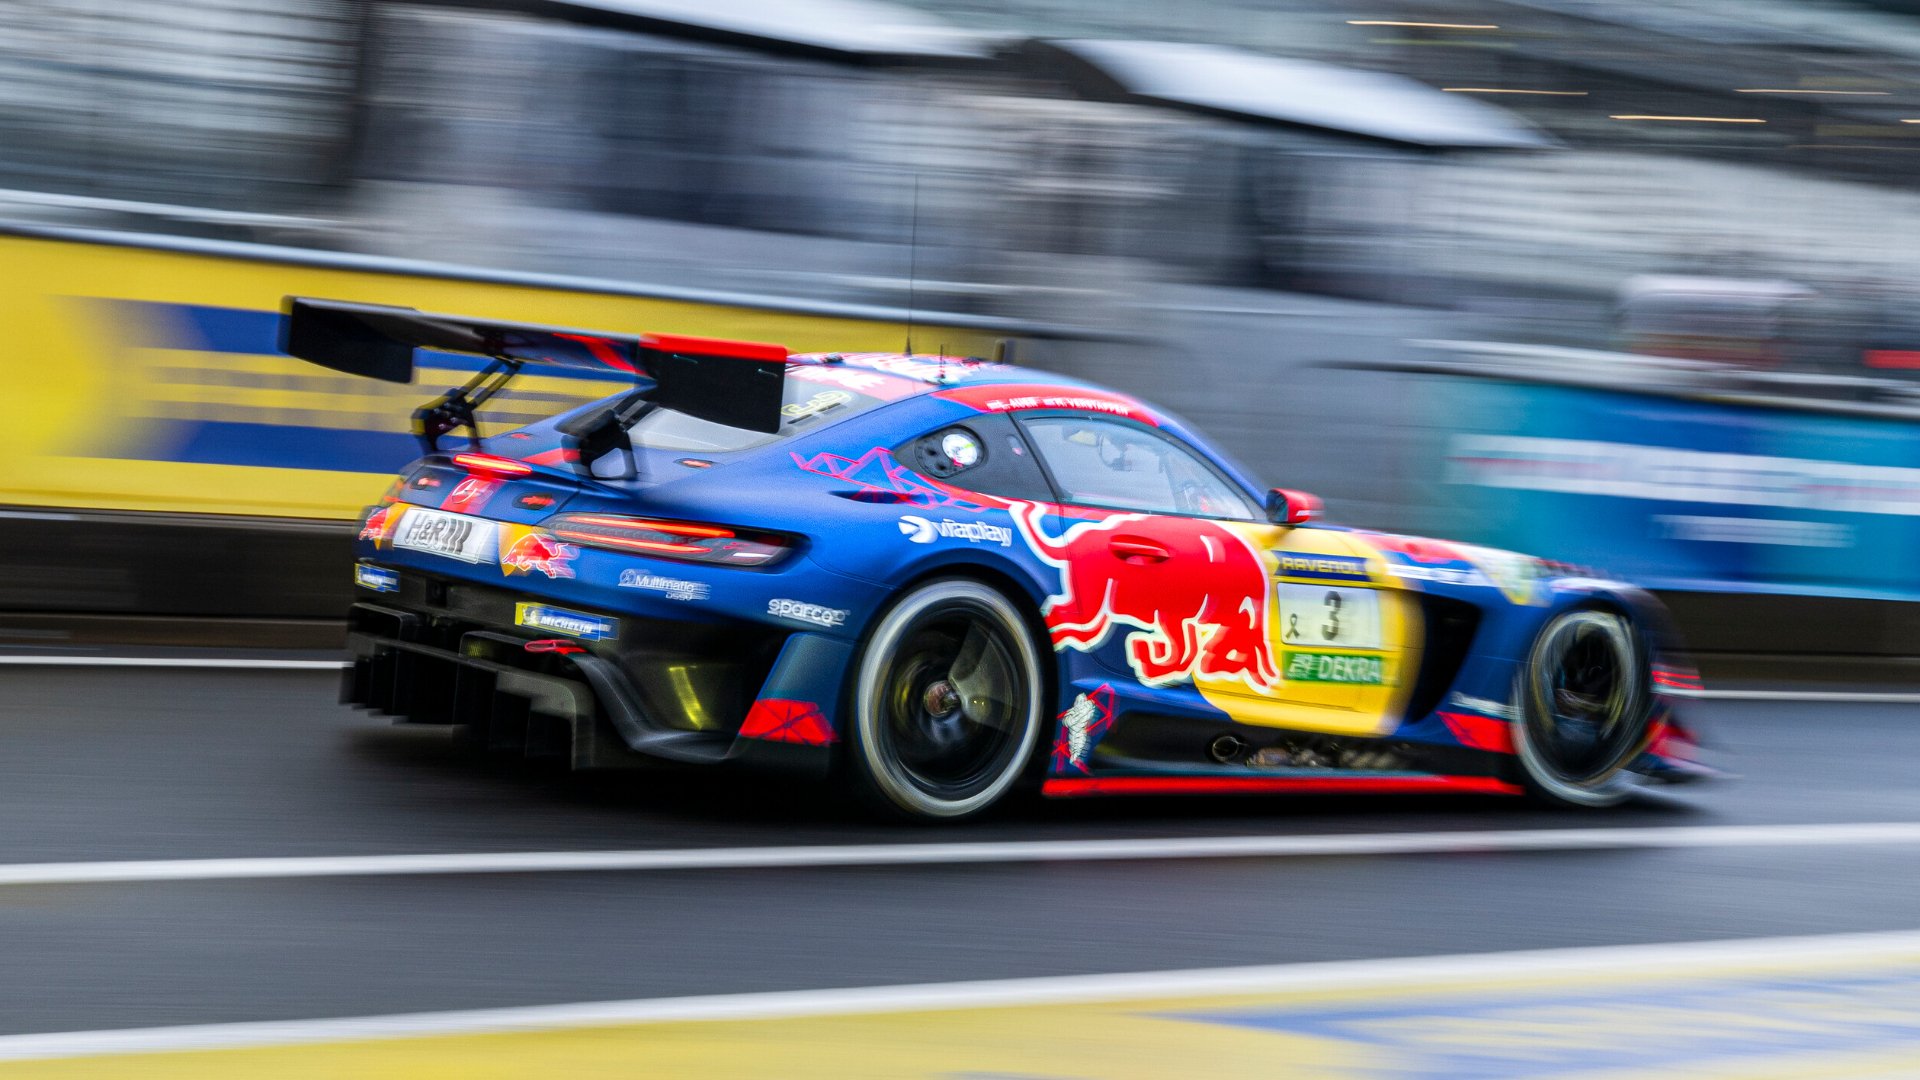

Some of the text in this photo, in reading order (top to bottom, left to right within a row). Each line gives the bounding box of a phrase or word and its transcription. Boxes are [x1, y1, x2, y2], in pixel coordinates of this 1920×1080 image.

[1282, 556, 1362, 575] RAVENOL
[768, 599, 836, 623] sparco
[1322, 591, 1342, 641] 3
[540, 615, 598, 634] MICHELIN
[1318, 655, 1381, 683] DEKRA
